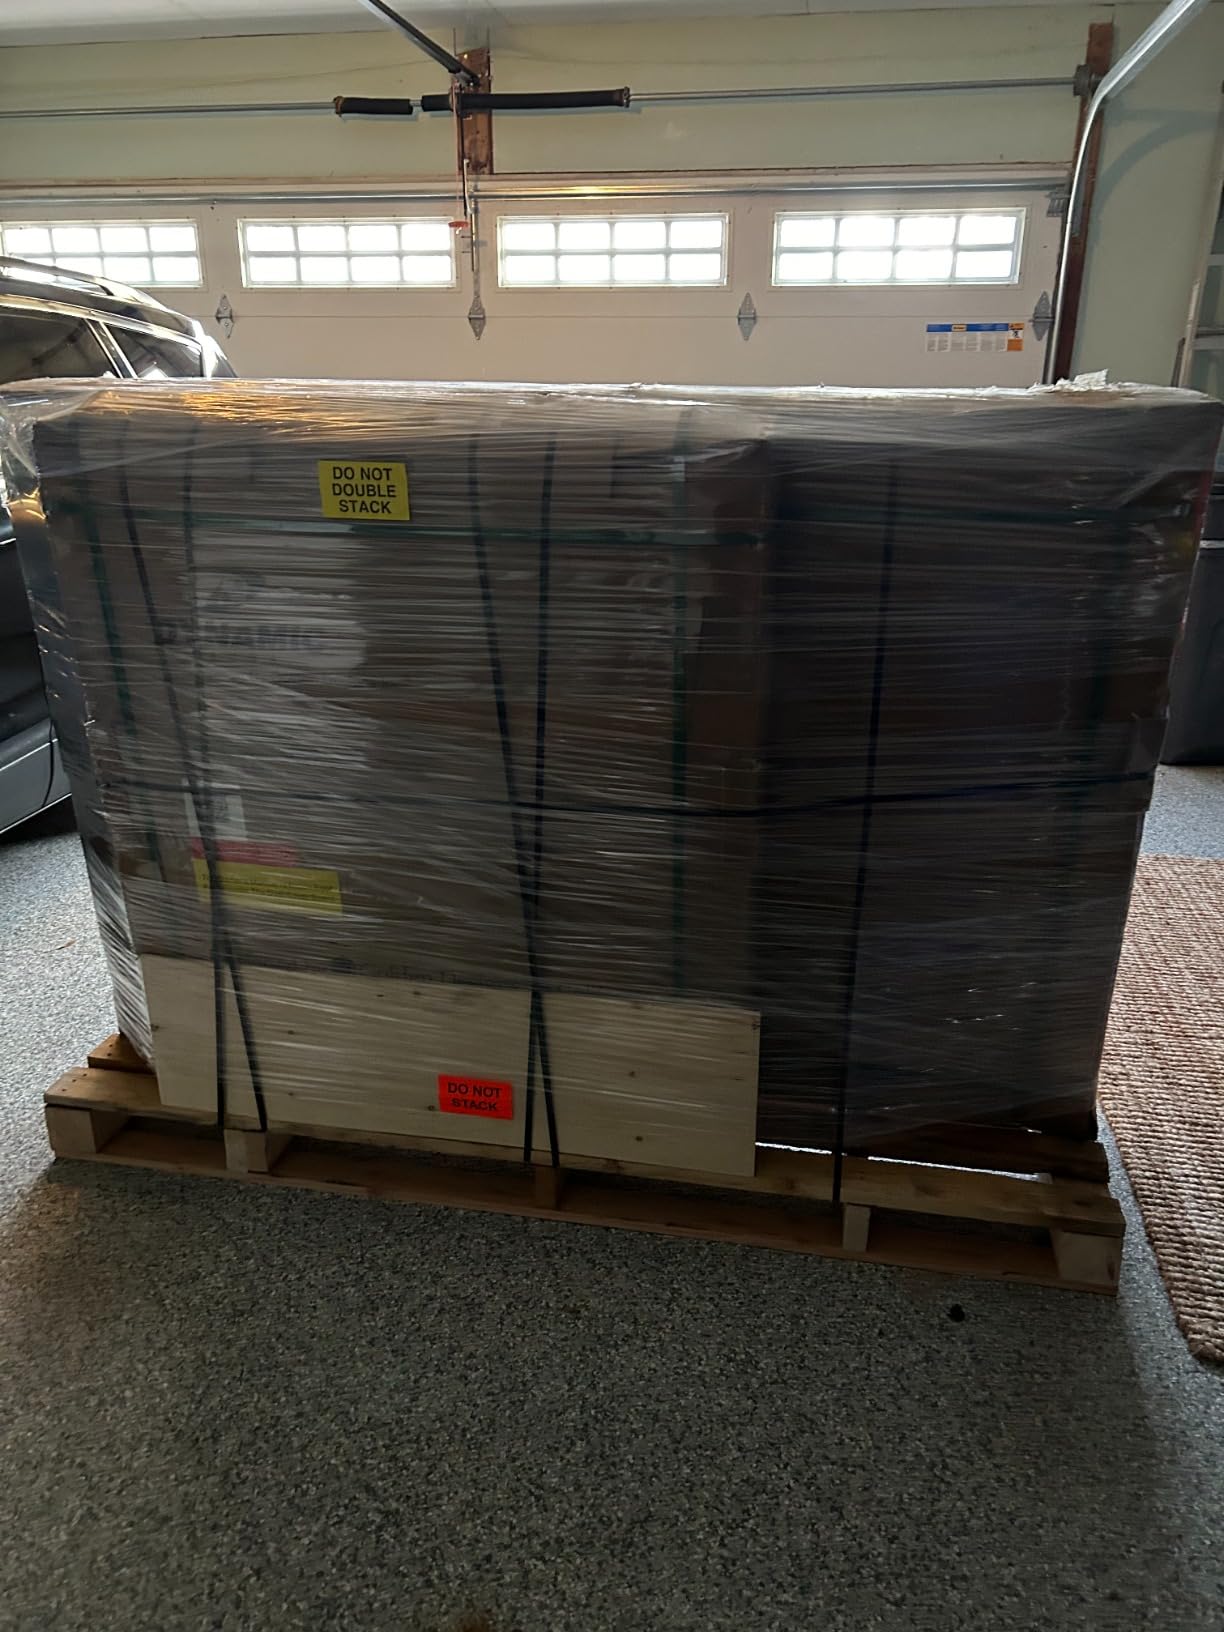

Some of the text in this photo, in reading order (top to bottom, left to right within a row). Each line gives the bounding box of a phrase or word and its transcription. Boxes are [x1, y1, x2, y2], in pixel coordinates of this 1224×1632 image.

[333, 467, 392, 481] DO NOT
[332, 483, 396, 498] DOUBLE
[339, 499, 392, 514] STACK
[447, 1082, 502, 1098] DO NOT
[451, 1098, 497, 1111] STACK
